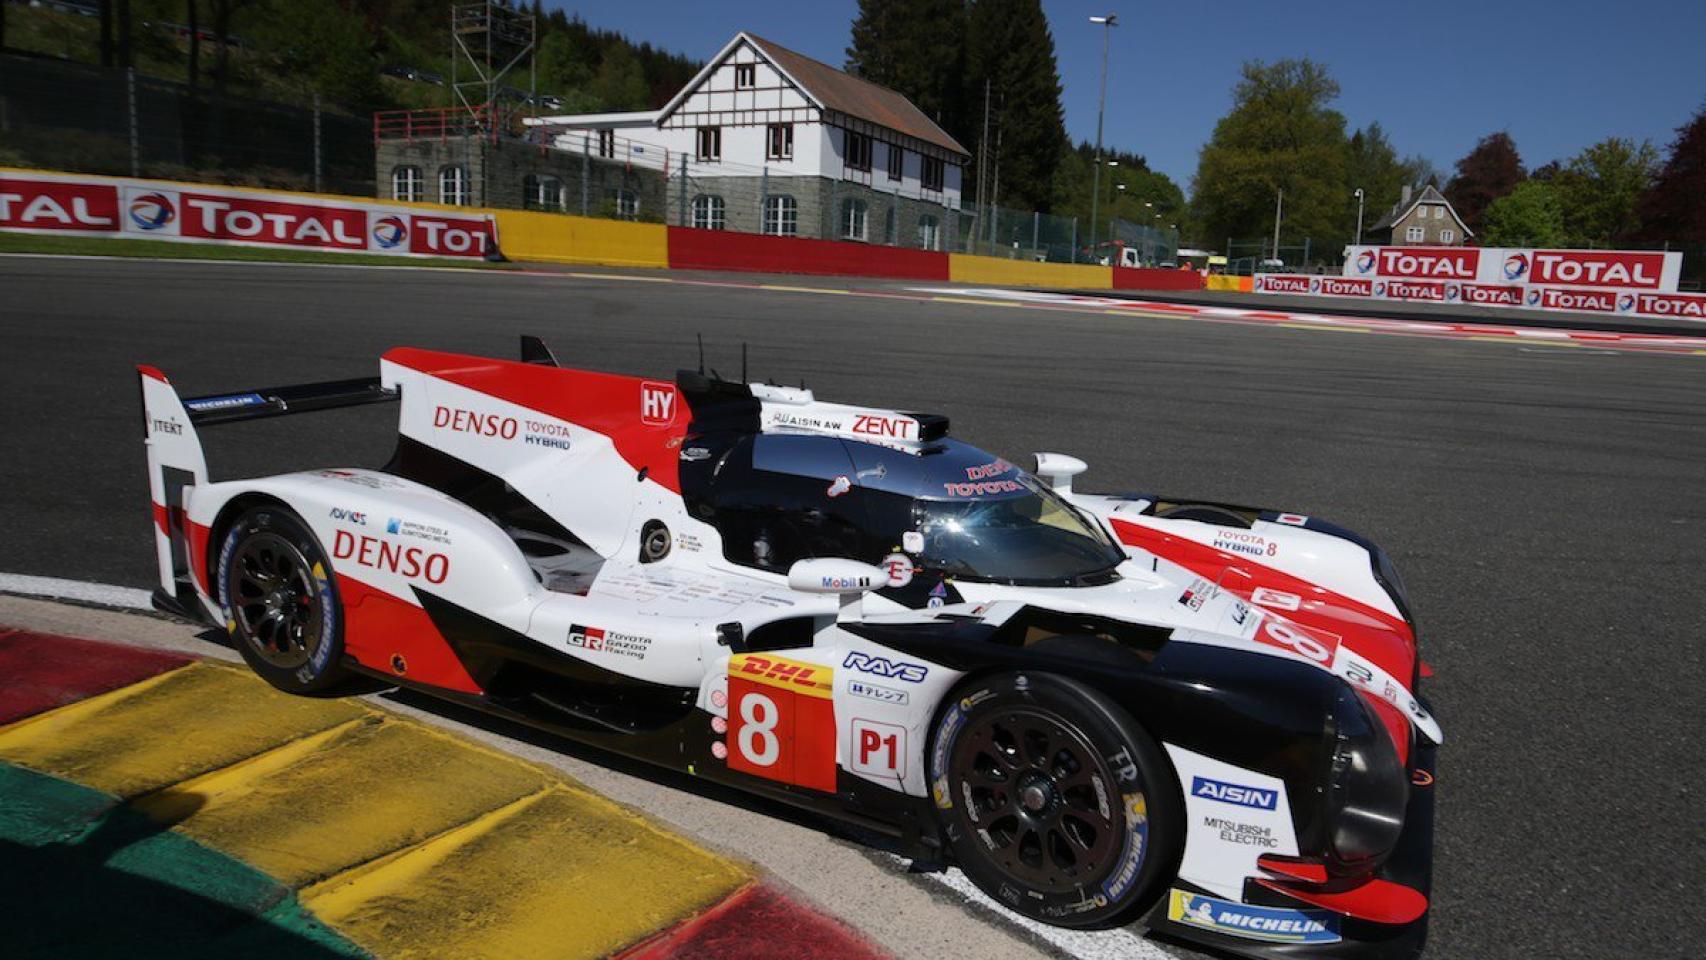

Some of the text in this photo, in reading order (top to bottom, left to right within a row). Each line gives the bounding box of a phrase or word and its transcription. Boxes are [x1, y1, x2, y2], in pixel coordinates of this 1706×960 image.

[187, 200, 363, 245] TOTAL
[1381, 250, 1475, 279] TOTAL
[1537, 256, 1656, 284] TOTAL
[1265, 277, 1308, 291] TOTAL
[1324, 280, 1370, 295] TOTAL
[1390, 282, 1443, 299] TOTAL
[1463, 286, 1520, 304] TOTAL
[1545, 291, 1613, 309] TOTAL
[1640, 296, 1706, 315] TOTA
[643, 389, 674, 419] HY
[434, 405, 517, 440] DENSO
[525, 420, 570, 438] TOYOTA
[790, 416, 821, 427] AISIN
[852, 414, 914, 438] ZENT
[525, 435, 570, 450] HYBRID
[1217, 530, 1265, 545] TOYOTA
[333, 529, 449, 584] DENSO
[1213, 540, 1264, 556] HYBRID
[1267, 542, 1277, 557] 8
[822, 576, 856, 588] Mobil
[608, 631, 652, 644] TOYOTA
[604, 646, 645, 660] Racing
[742, 656, 817, 688] DHL
[843, 651, 928, 683] RAYS
[738, 692, 779, 767] 8
[860, 728, 897, 770] P1
[1199, 780, 1273, 807] AISIN
[1204, 817, 1271, 837] MITSUBISHI
[1220, 830, 1278, 849] ELECTRIC
[1218, 911, 1327, 932] MICHELIN
